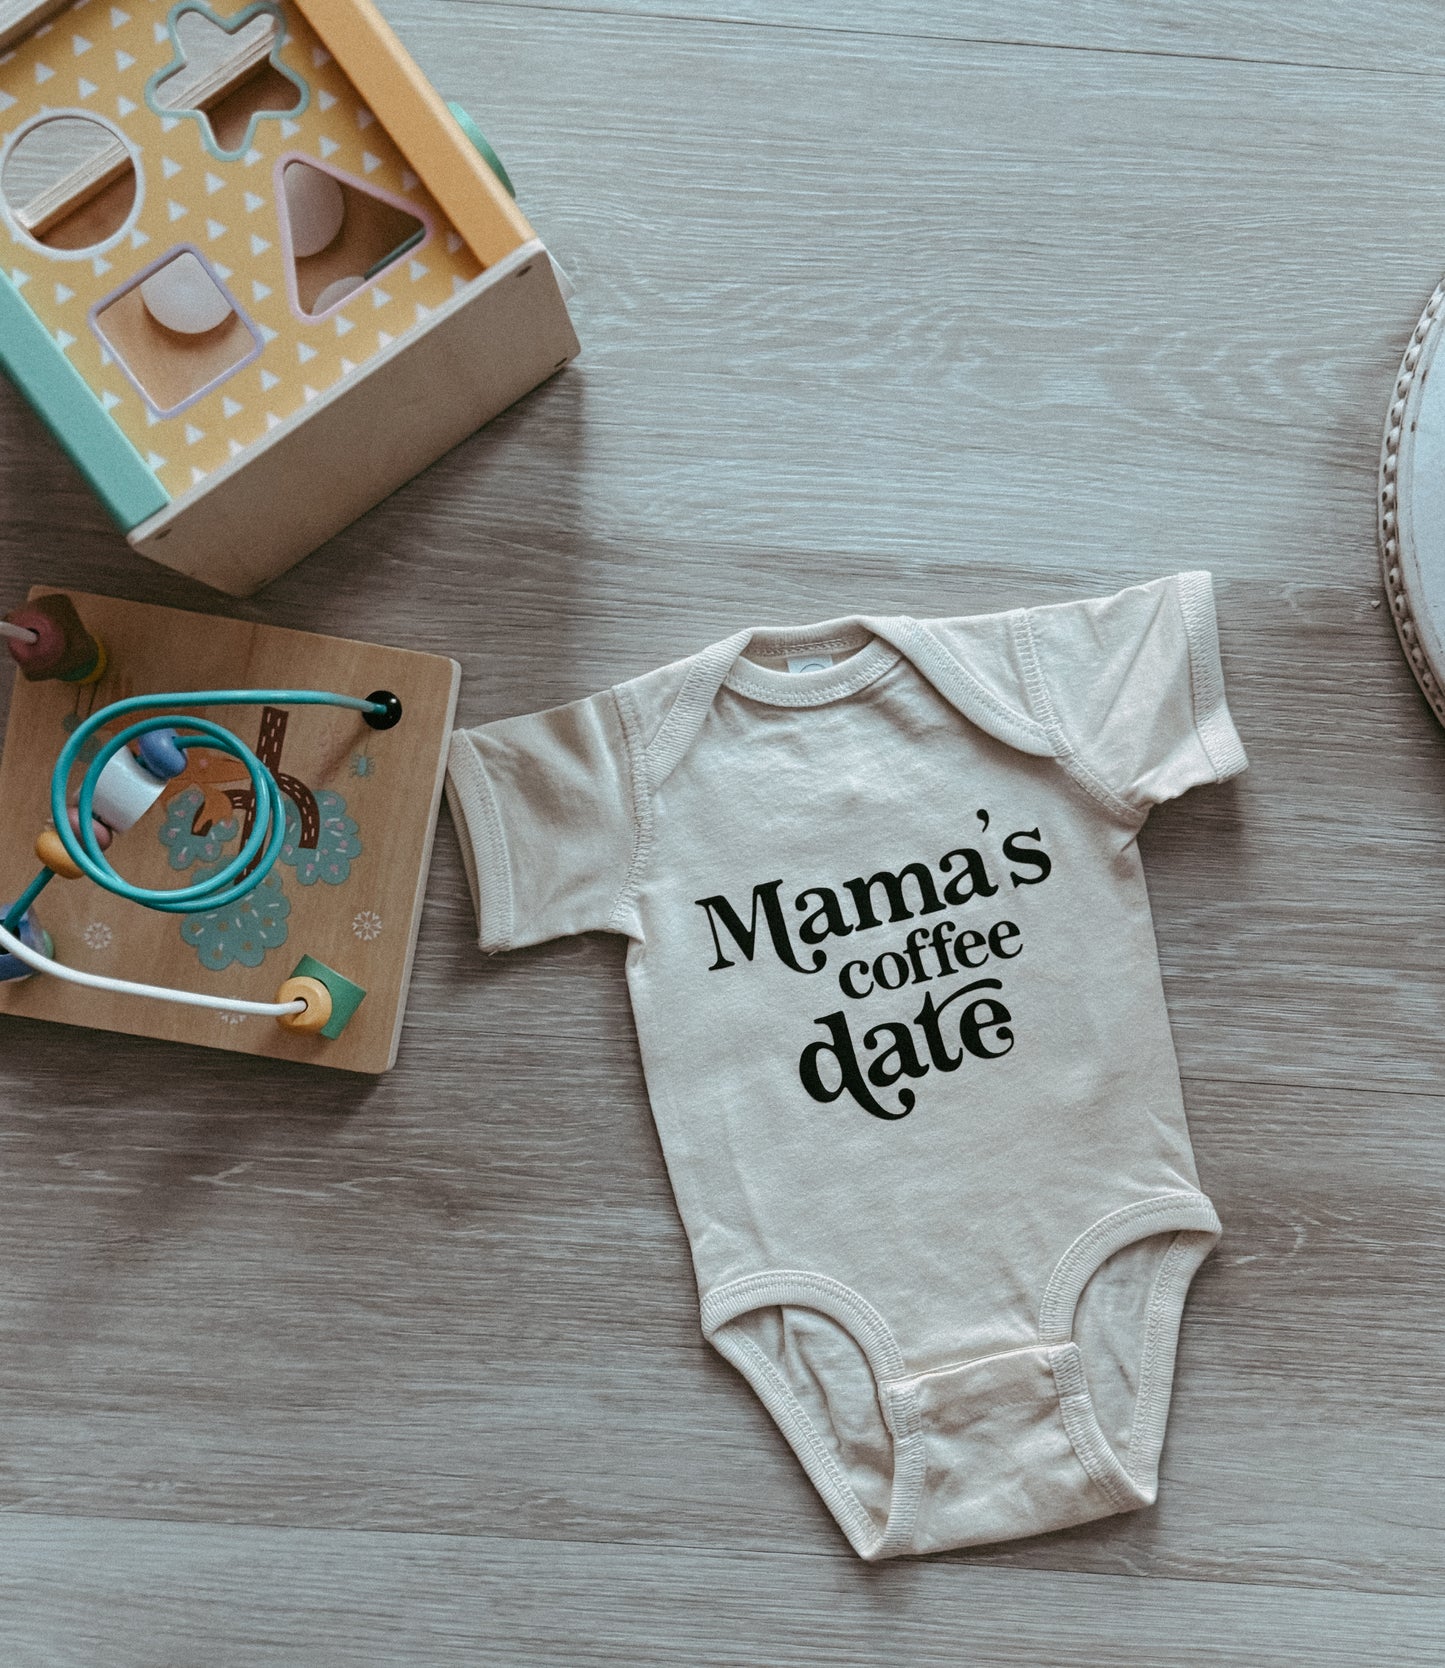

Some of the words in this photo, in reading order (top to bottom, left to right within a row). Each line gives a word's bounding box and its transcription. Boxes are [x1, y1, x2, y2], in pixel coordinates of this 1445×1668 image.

[694, 808, 1052, 975] Mama's
[838, 920, 1024, 1000] coffee
[798, 977, 1015, 1121] date
